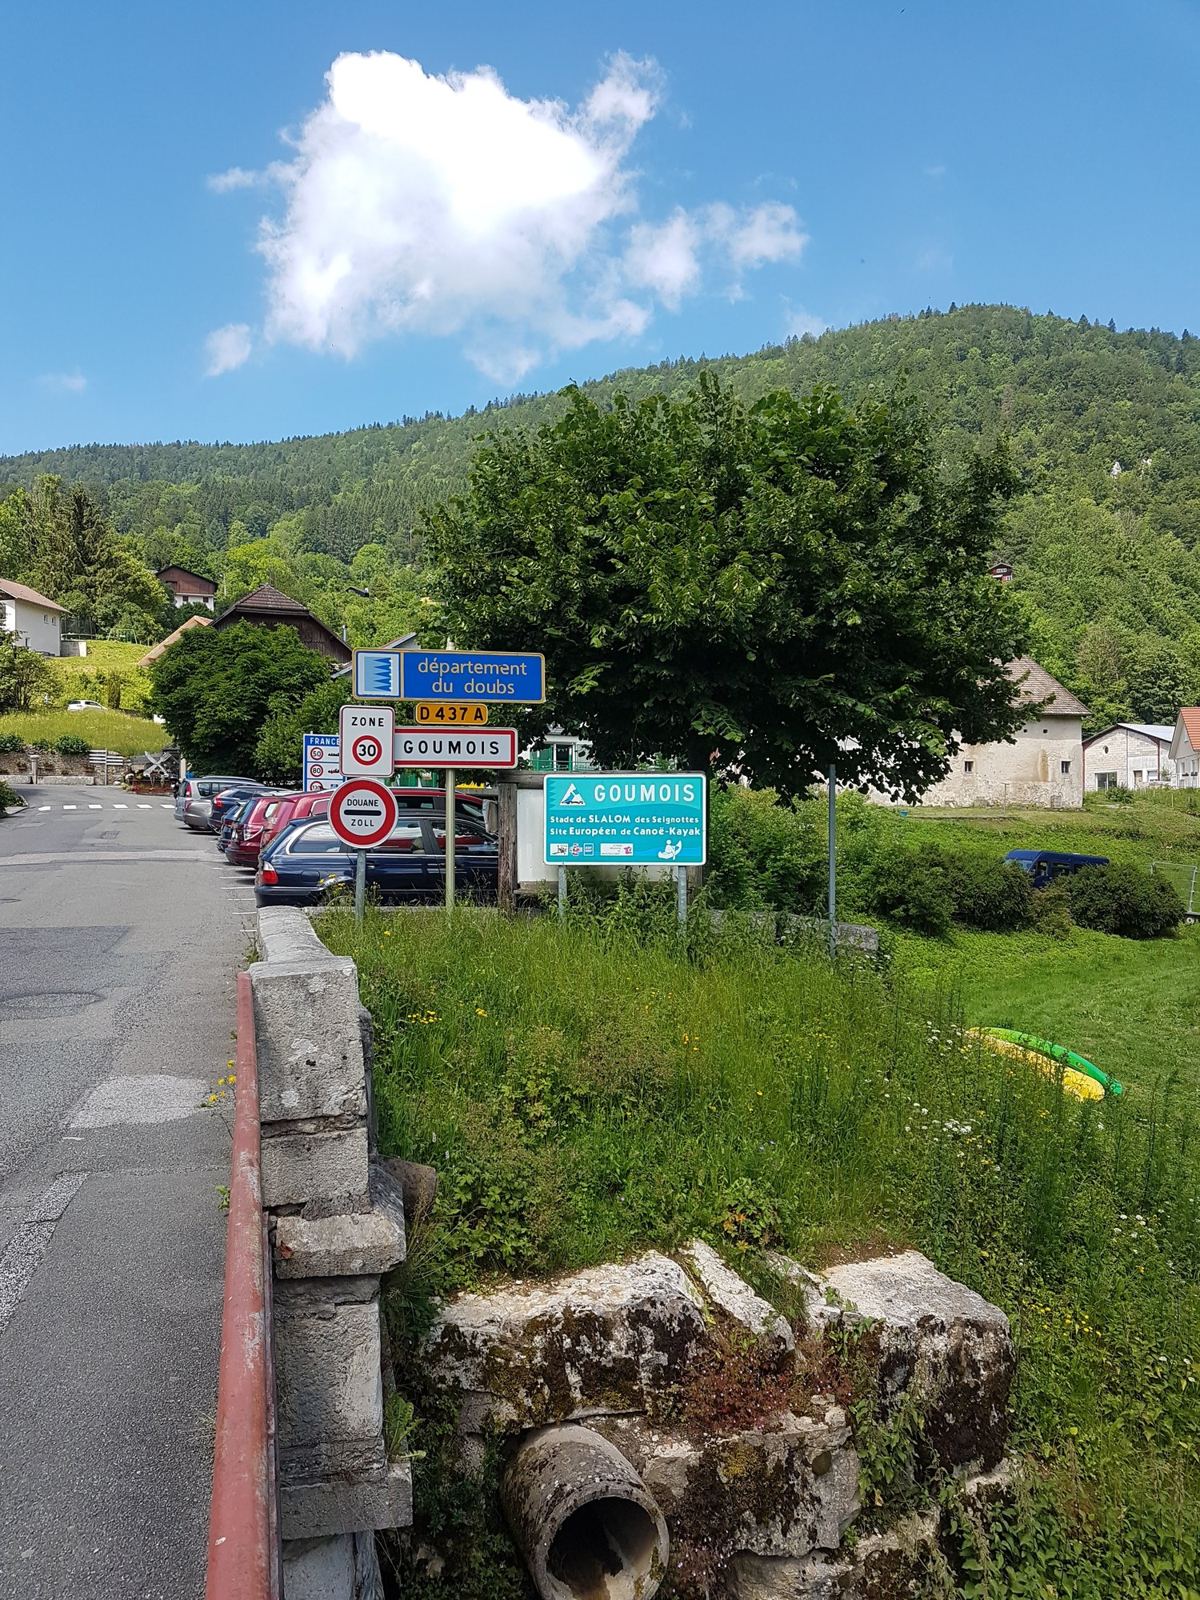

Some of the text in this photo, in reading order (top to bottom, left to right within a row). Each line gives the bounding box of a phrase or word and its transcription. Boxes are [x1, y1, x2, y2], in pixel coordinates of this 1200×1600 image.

[417, 657, 527, 677] département
[431, 678, 515, 695] du doubs
[420, 706, 484, 721] D 437 A
[351, 716, 385, 727] ZONE
[358, 744, 377, 757] 30
[403, 740, 500, 755] GOUMOIS
[312, 766, 321, 774] 80
[594, 784, 695, 802] GOUMOIS
[347, 799, 379, 807] DOUANE
[351, 818, 375, 827] ZOLL
[550, 814, 699, 824] Stade de SLALOM des Seignottes
[569, 827, 617, 837] Européen
[633, 827, 700, 837] Canoë-Kayak
